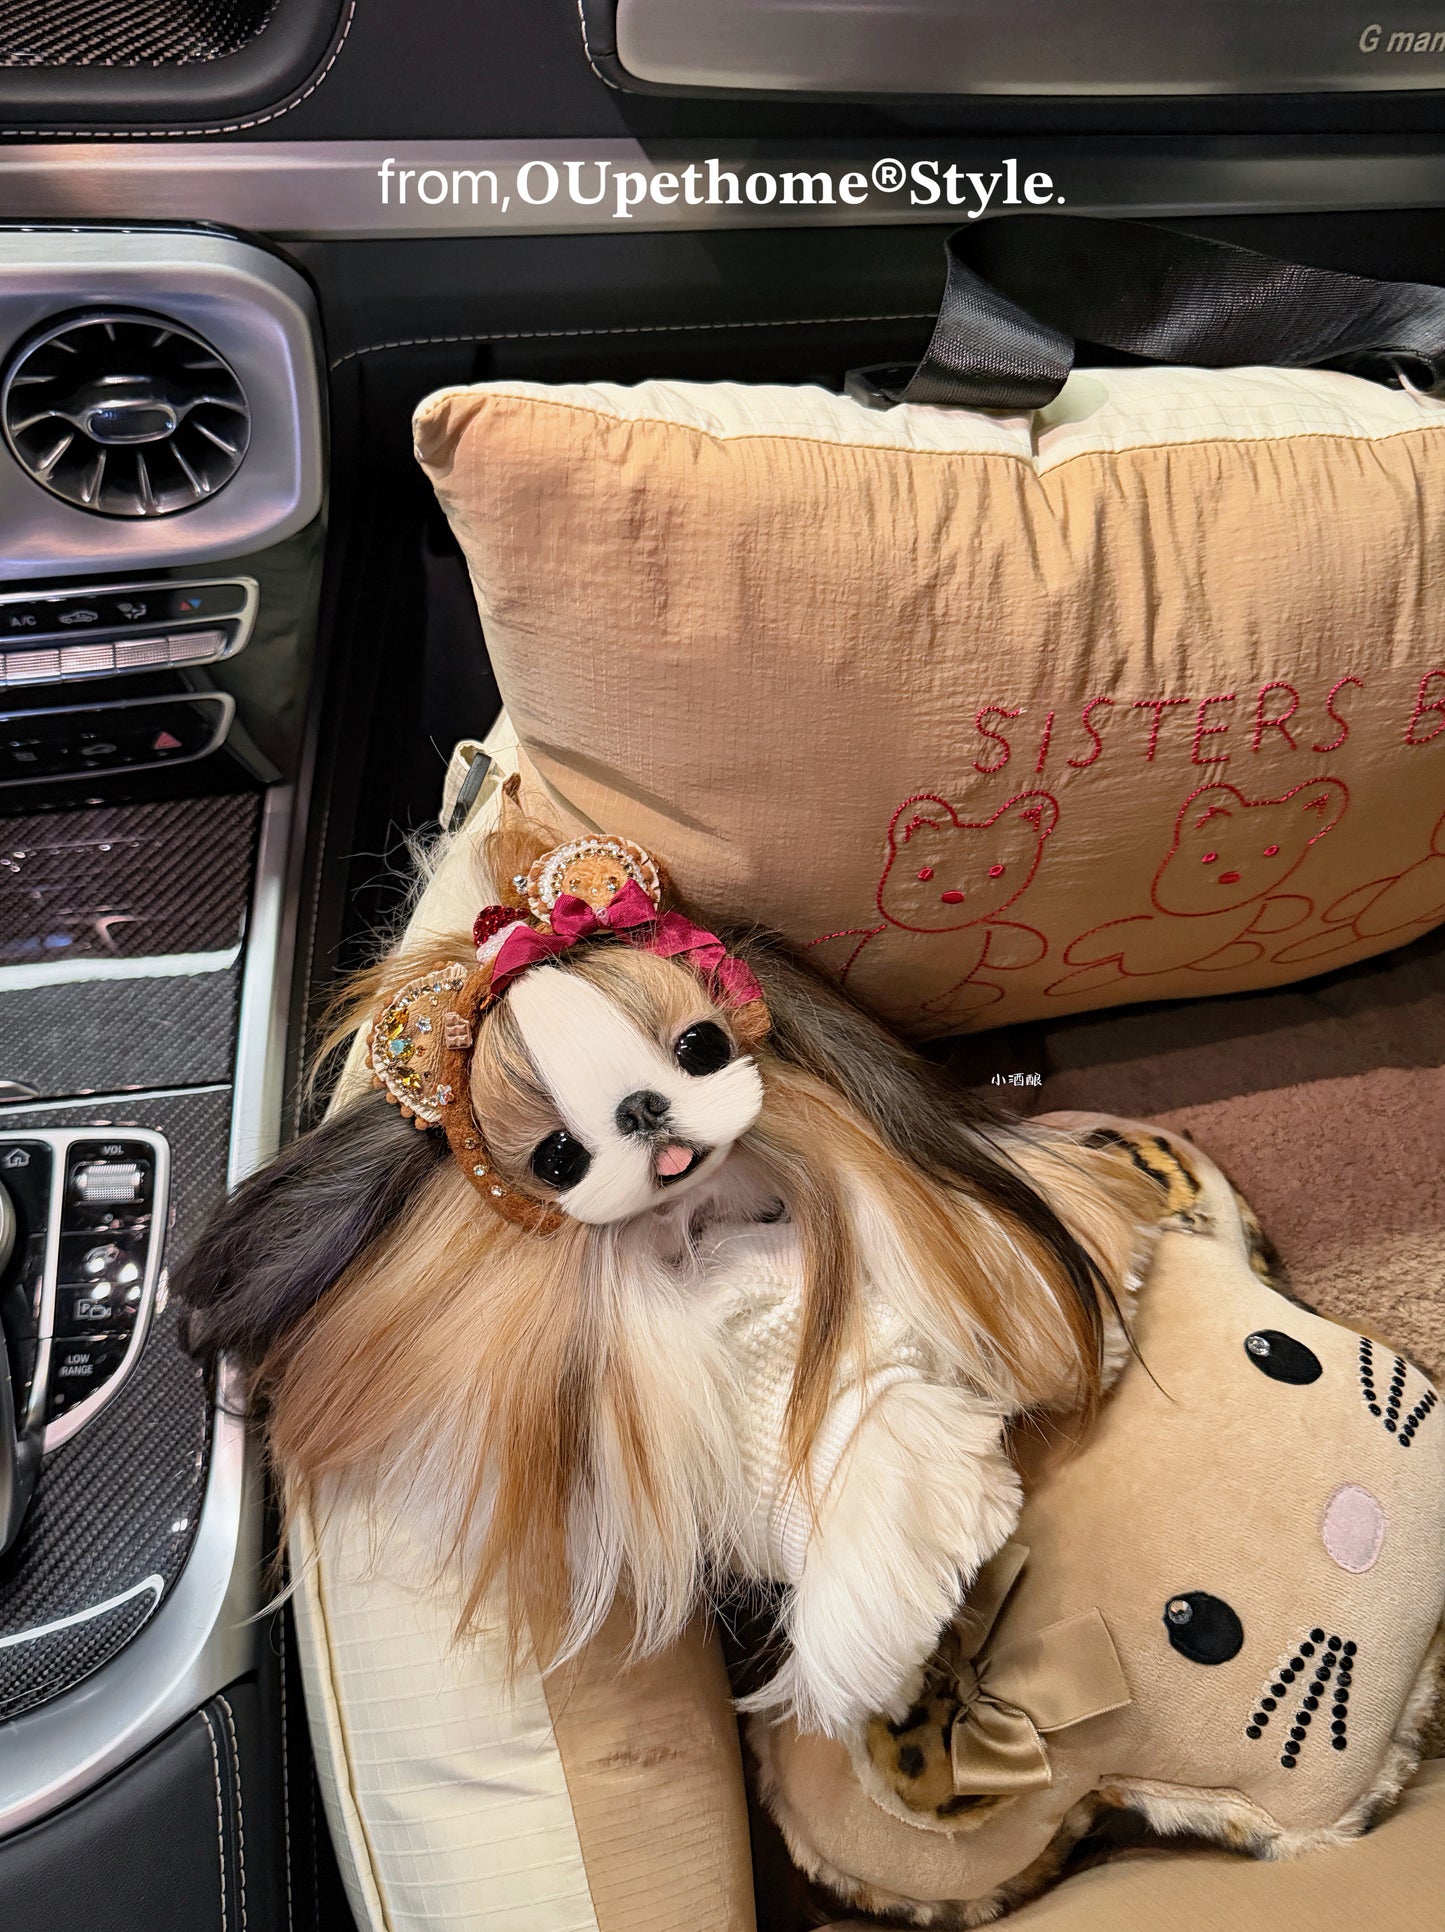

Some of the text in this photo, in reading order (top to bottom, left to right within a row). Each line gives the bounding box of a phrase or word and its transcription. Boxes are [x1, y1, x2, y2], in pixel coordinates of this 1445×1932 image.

[1358, 23, 1383, 53] G
[10, 615, 38, 628] A/C
[972, 675, 1364, 774] SISTERS
[102, 1145, 125, 1156] VOL
[68, 1353, 91, 1365] LOW
[61, 1364, 94, 1376] RANGE
